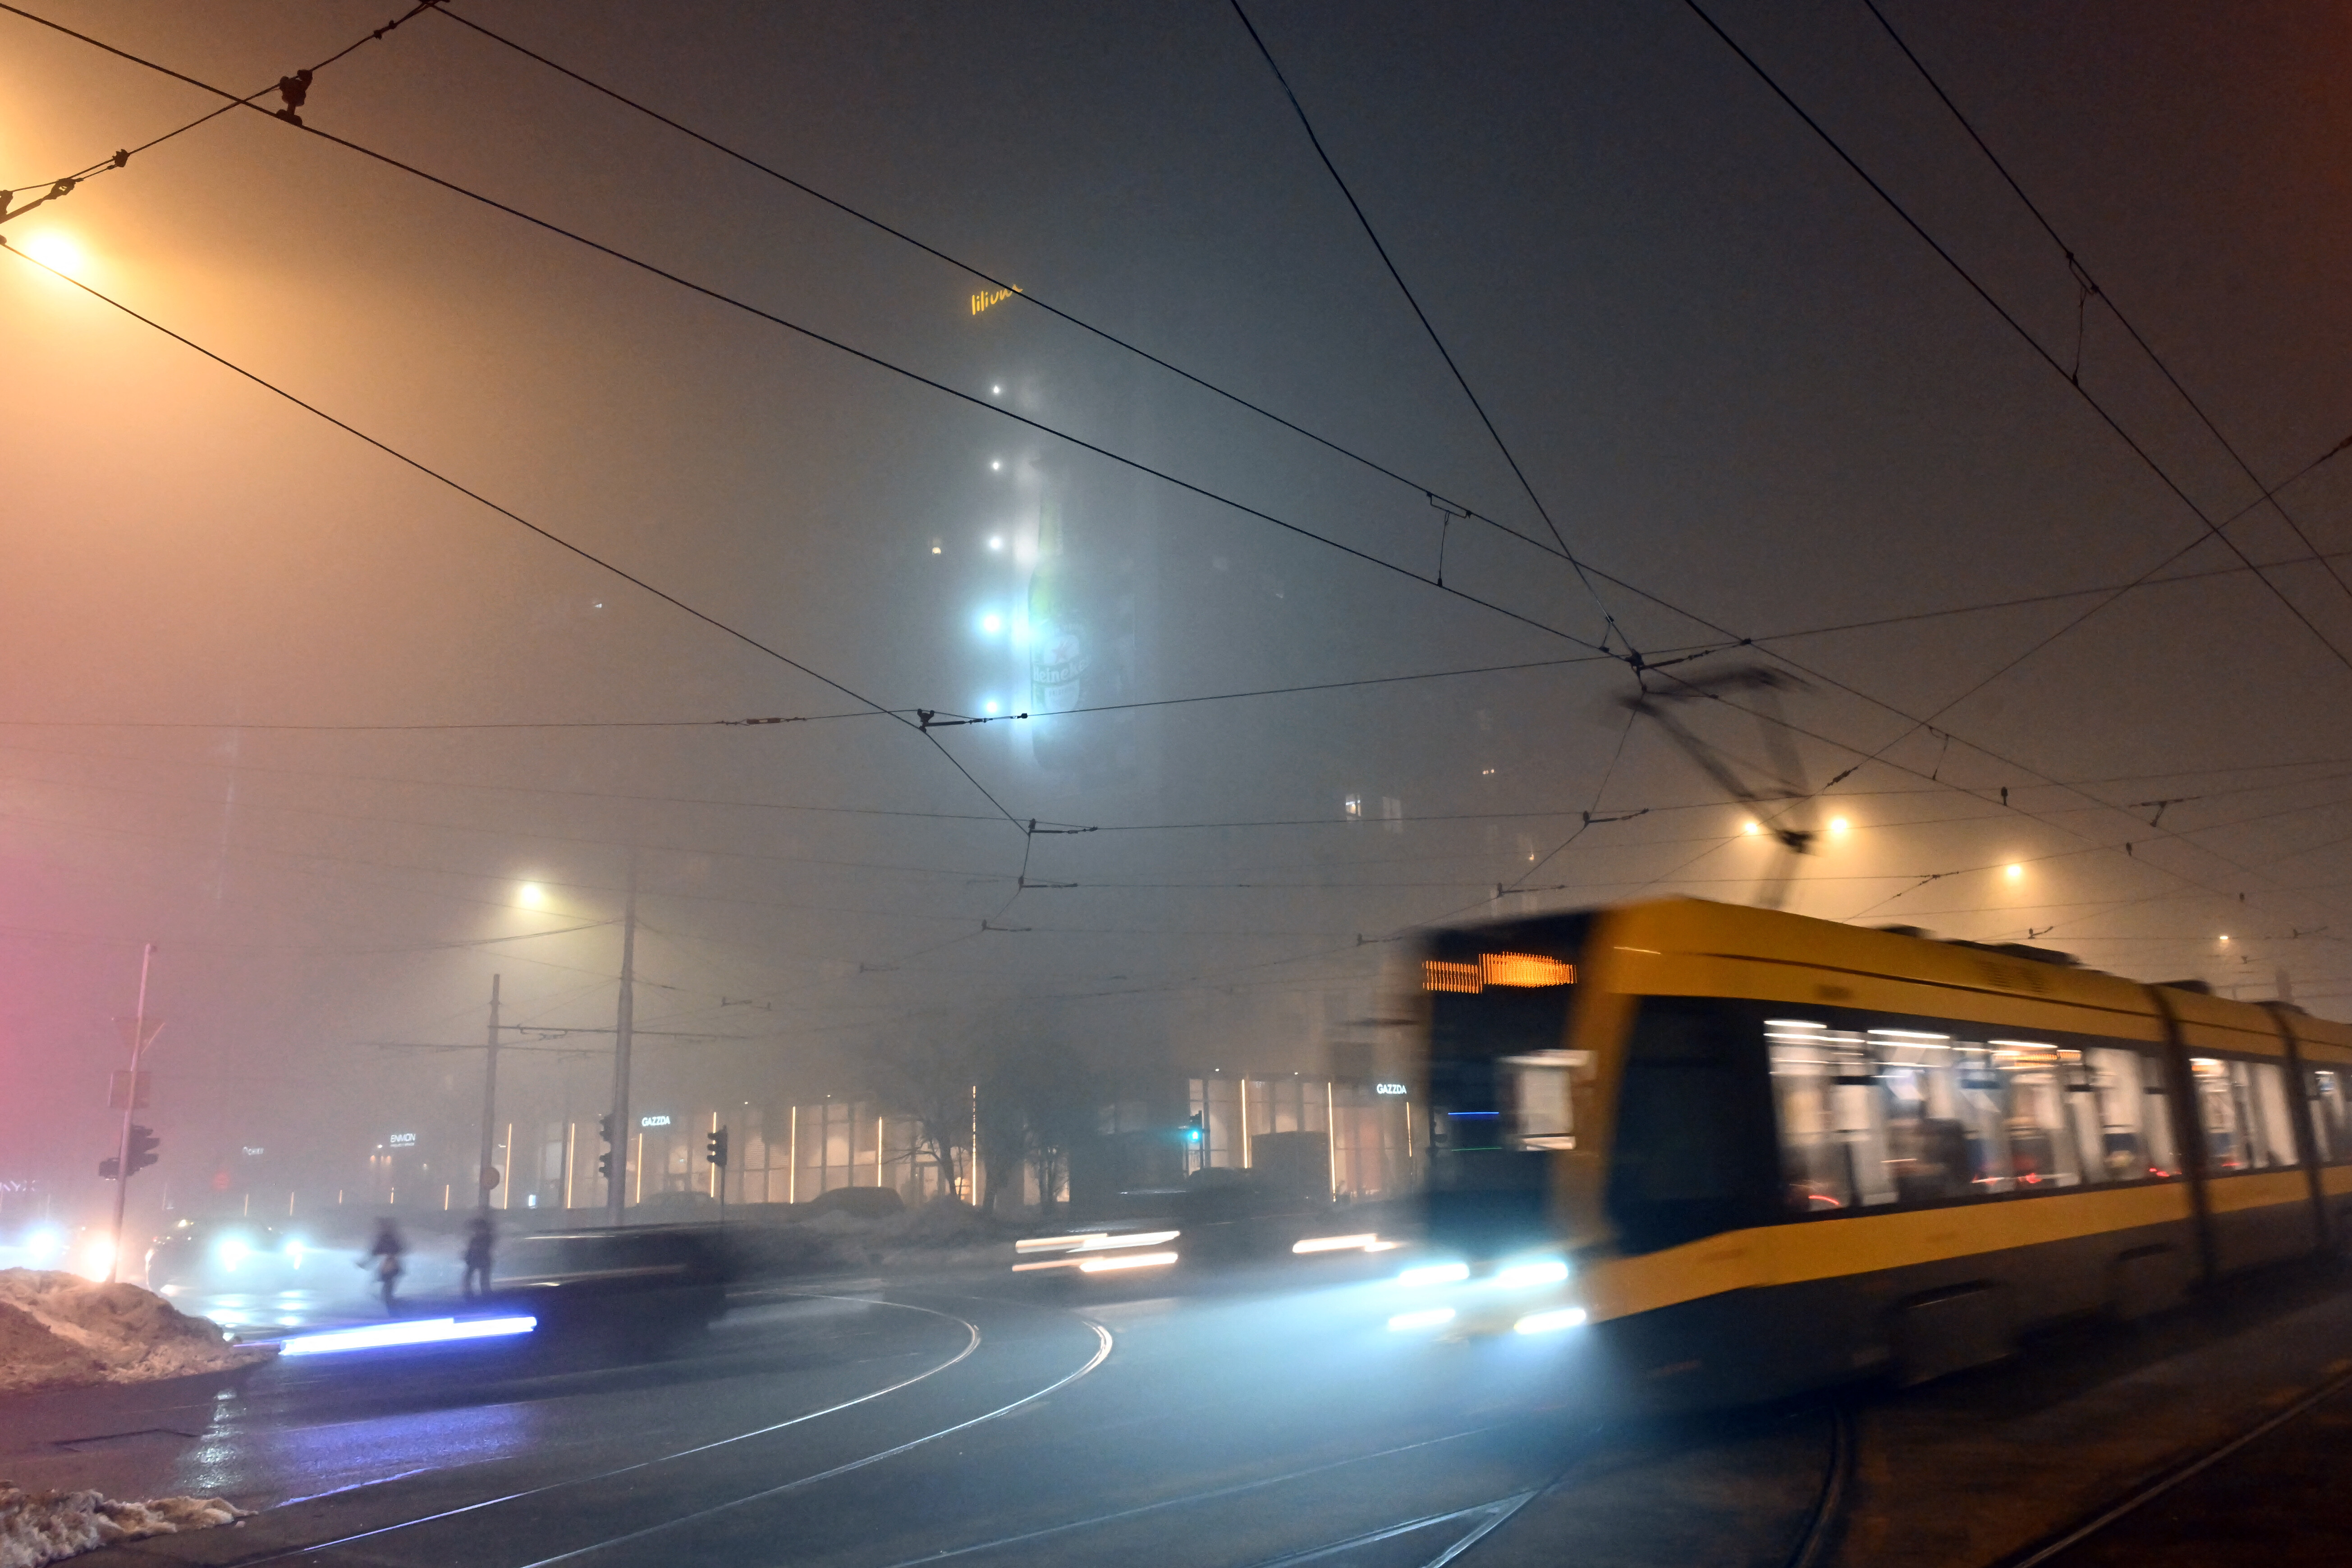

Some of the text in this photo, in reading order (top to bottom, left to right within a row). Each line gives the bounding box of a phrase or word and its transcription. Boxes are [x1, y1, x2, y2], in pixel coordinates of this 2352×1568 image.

[1033, 654, 1092, 683] Heineke
[1376, 1083, 1407, 1094] GAZZDA
[642, 1116, 670, 1127] GAZZDA
